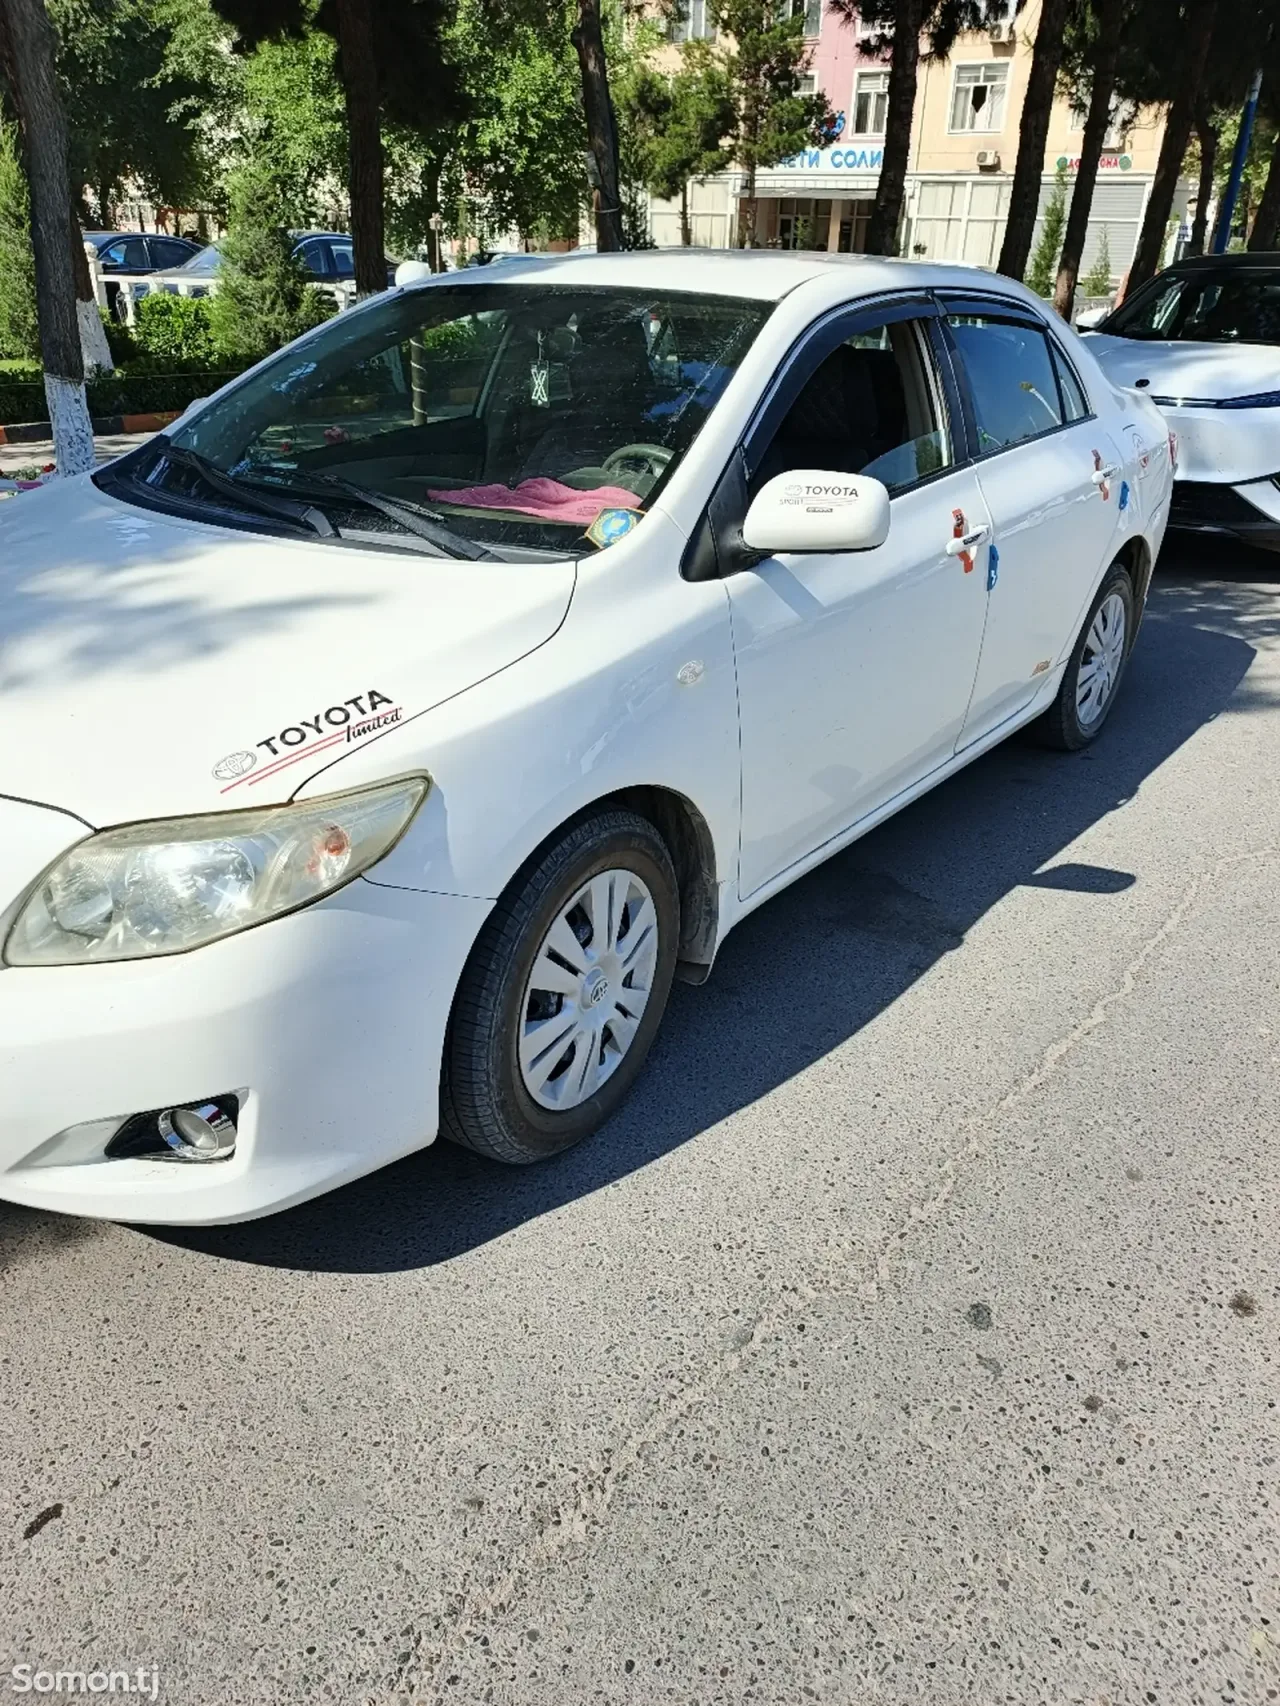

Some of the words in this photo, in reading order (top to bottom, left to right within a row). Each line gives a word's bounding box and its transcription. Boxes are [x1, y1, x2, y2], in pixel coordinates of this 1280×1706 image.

[831, 150, 882, 168] СОЛИ
[805, 485, 859, 498] TOYOTA
[256, 690, 394, 756] TOYOTA
